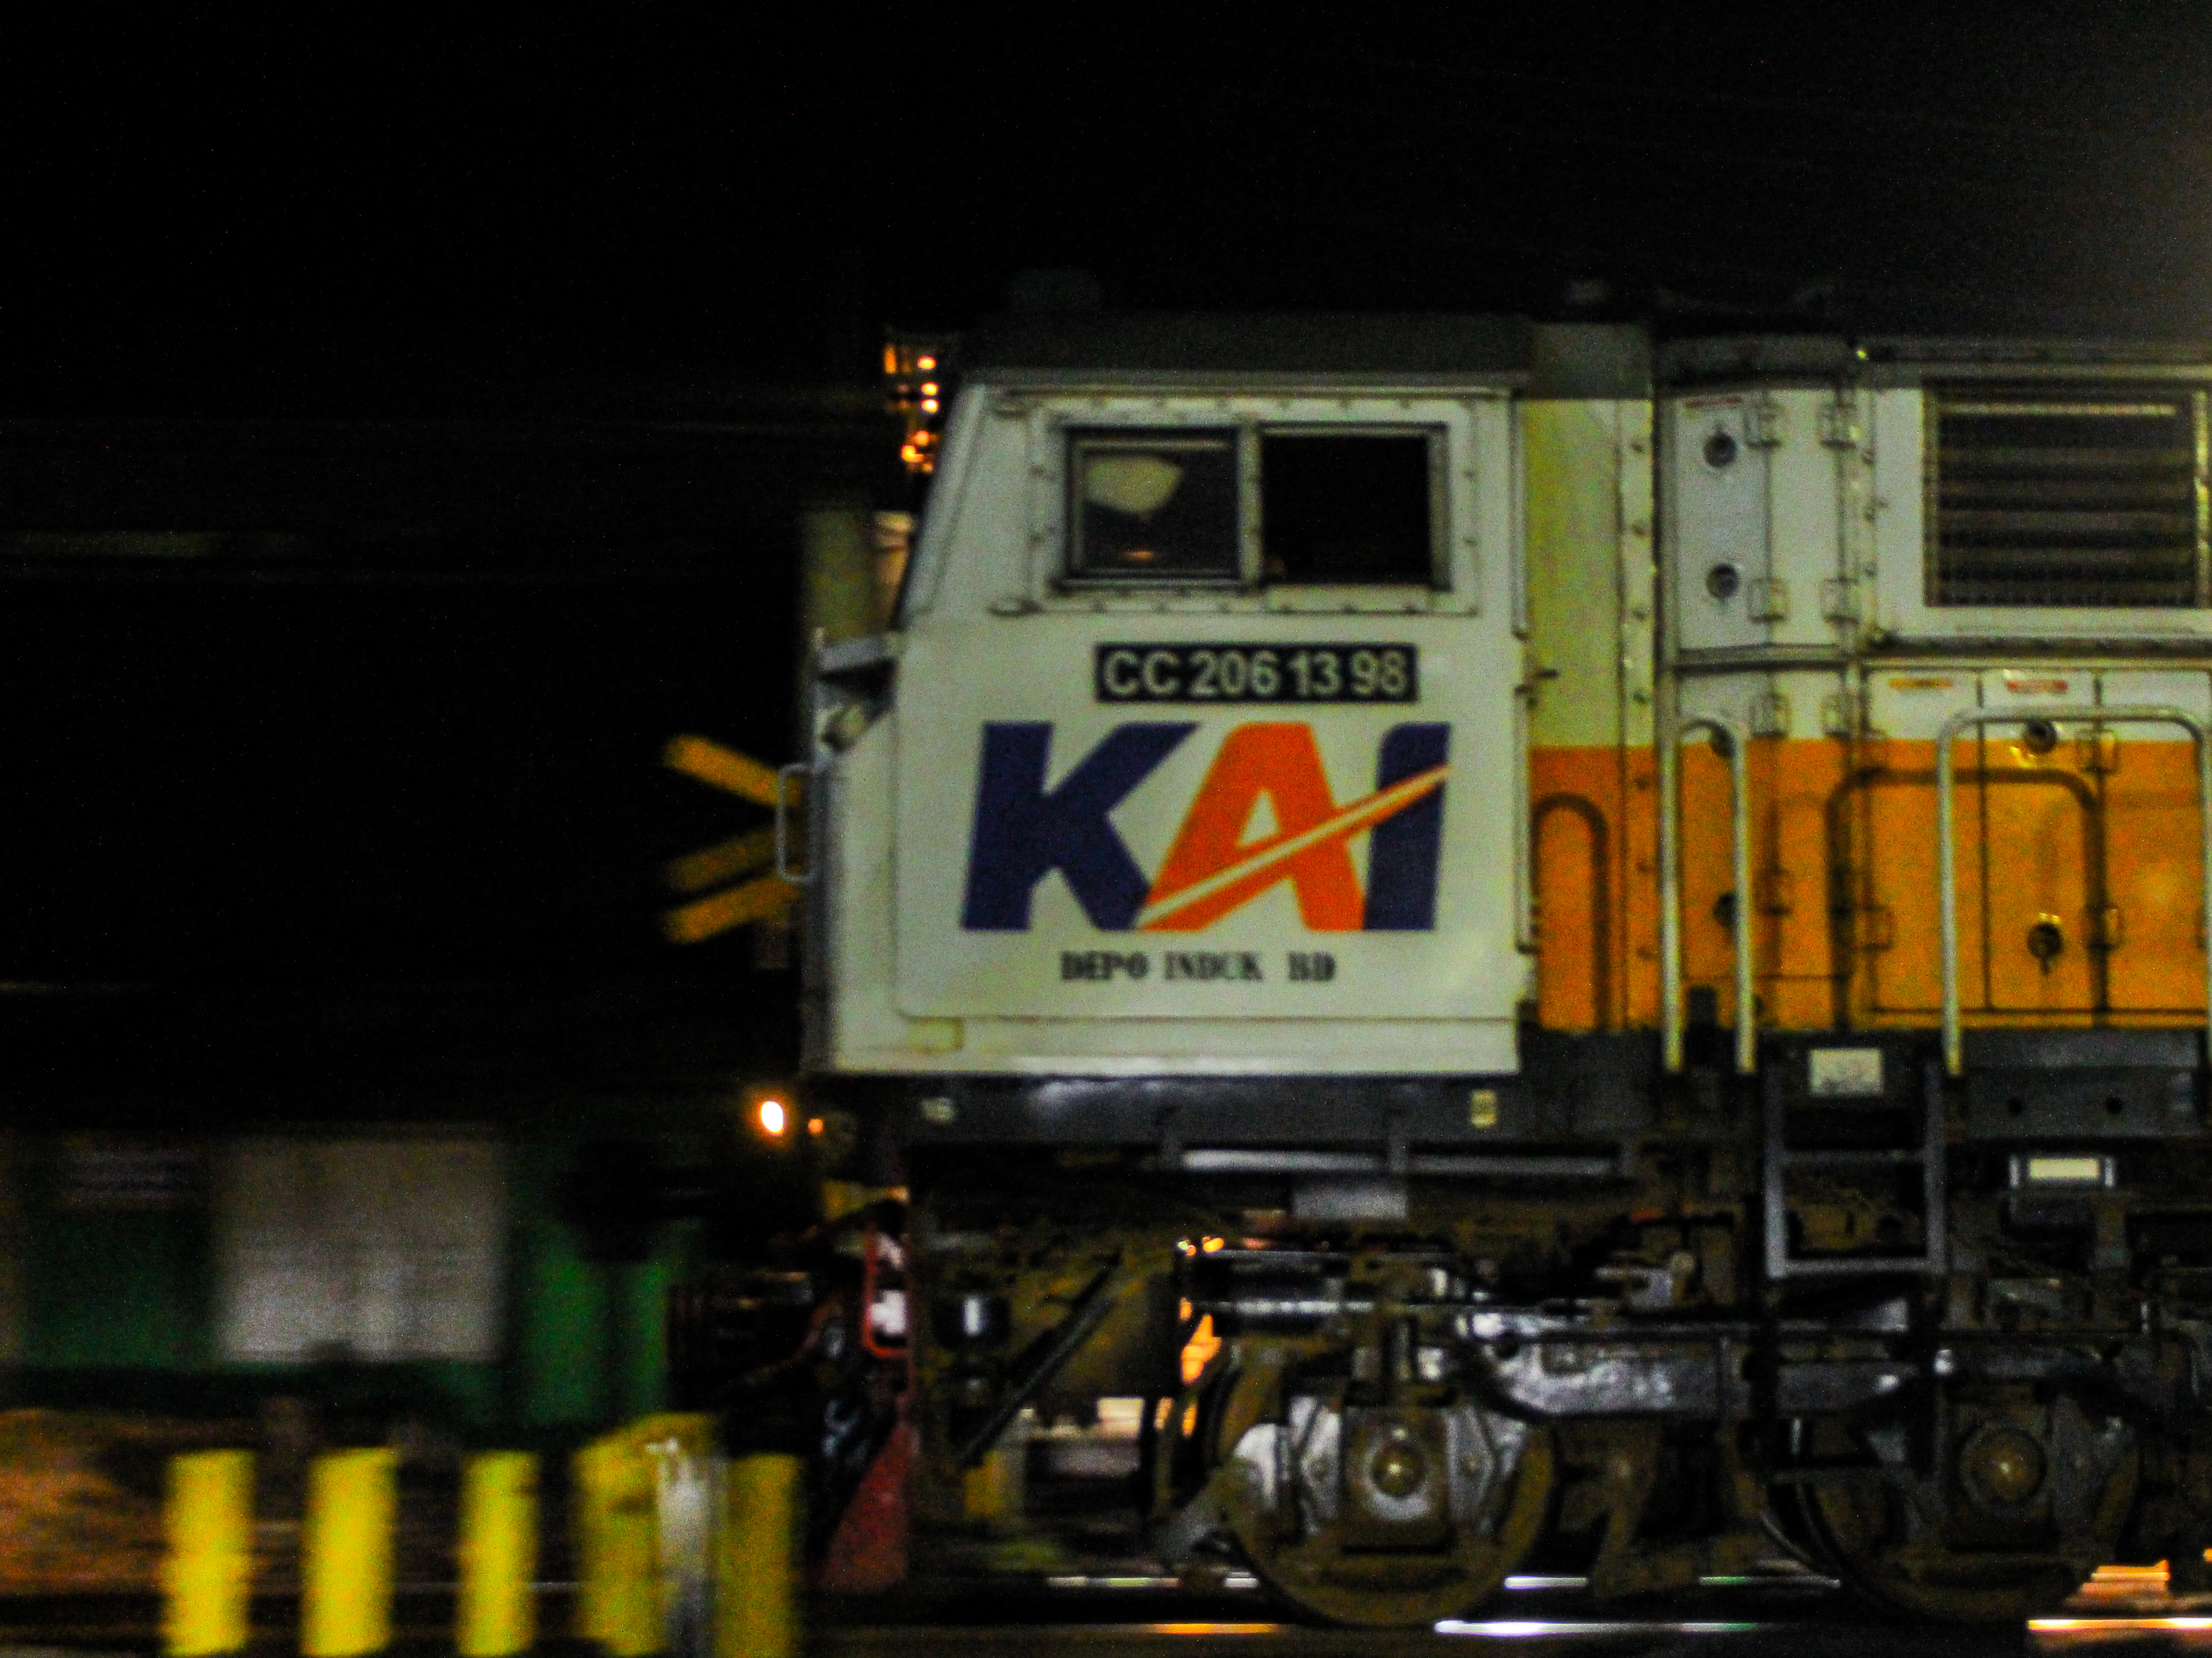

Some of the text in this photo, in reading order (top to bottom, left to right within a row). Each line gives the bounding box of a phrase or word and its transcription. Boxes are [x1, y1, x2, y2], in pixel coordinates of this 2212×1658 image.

[1105, 650, 1406, 696] CC 206 13 98
[961, 721, 1452, 931] KAI
[1061, 951, 1148, 981] DEPO
[1164, 951, 1264, 981] INDUK
